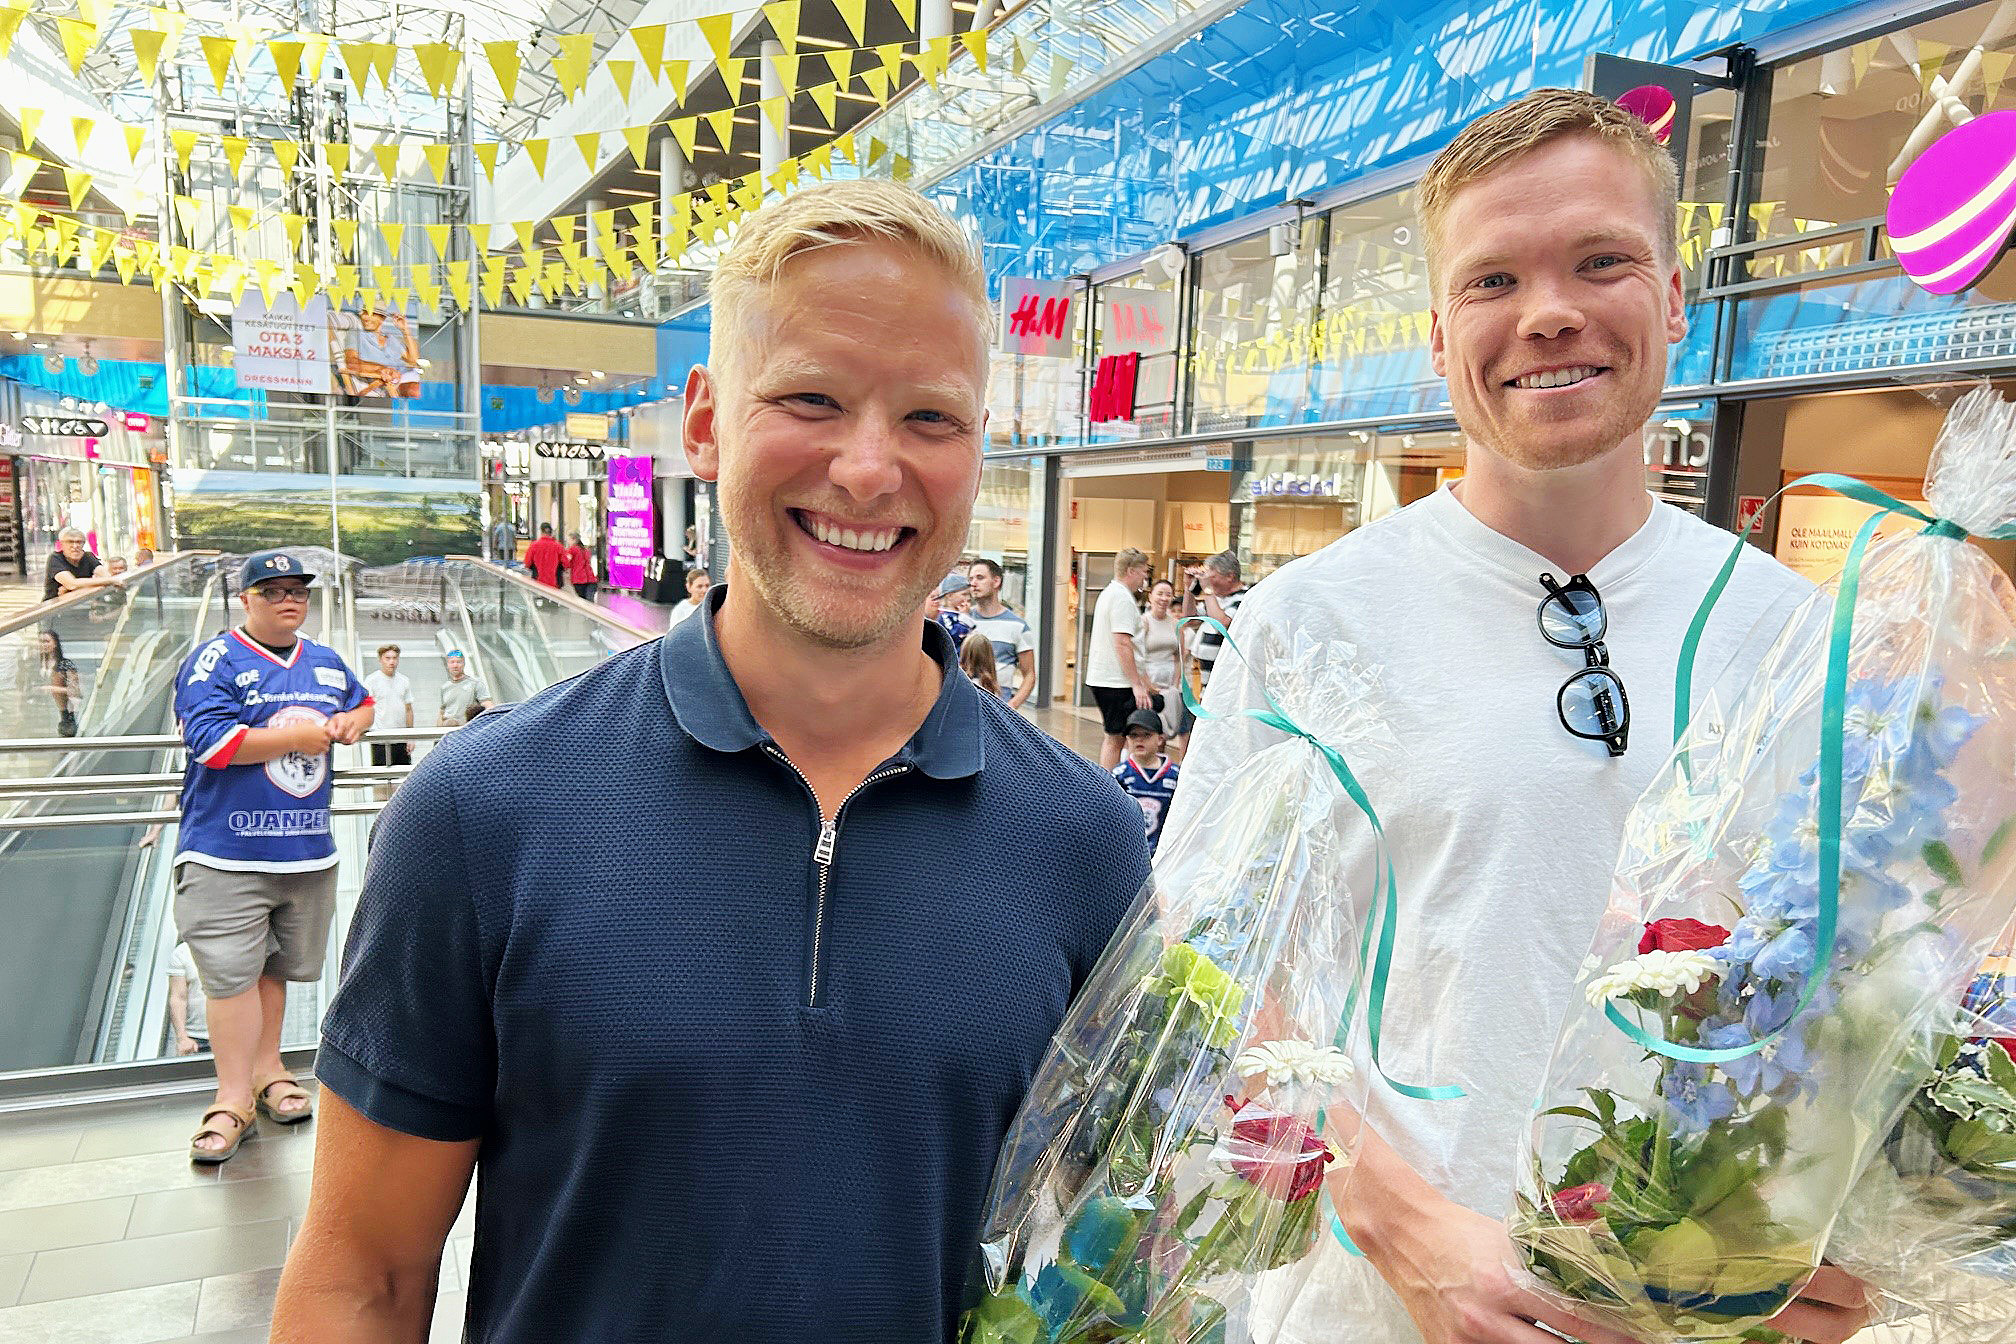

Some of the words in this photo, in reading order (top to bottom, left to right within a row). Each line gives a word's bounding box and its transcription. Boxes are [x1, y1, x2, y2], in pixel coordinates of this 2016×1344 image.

[1010, 293, 1070, 340] H&M
[260, 332, 290, 344] OTA
[294, 333, 303, 345] 3
[248, 346, 303, 359] MAKSA
[307, 349, 316, 360] 2
[244, 375, 312, 385] DRESSMANN
[1808, 528, 1859, 540] MAAILMALL
[1790, 539, 1808, 549] KUIN
